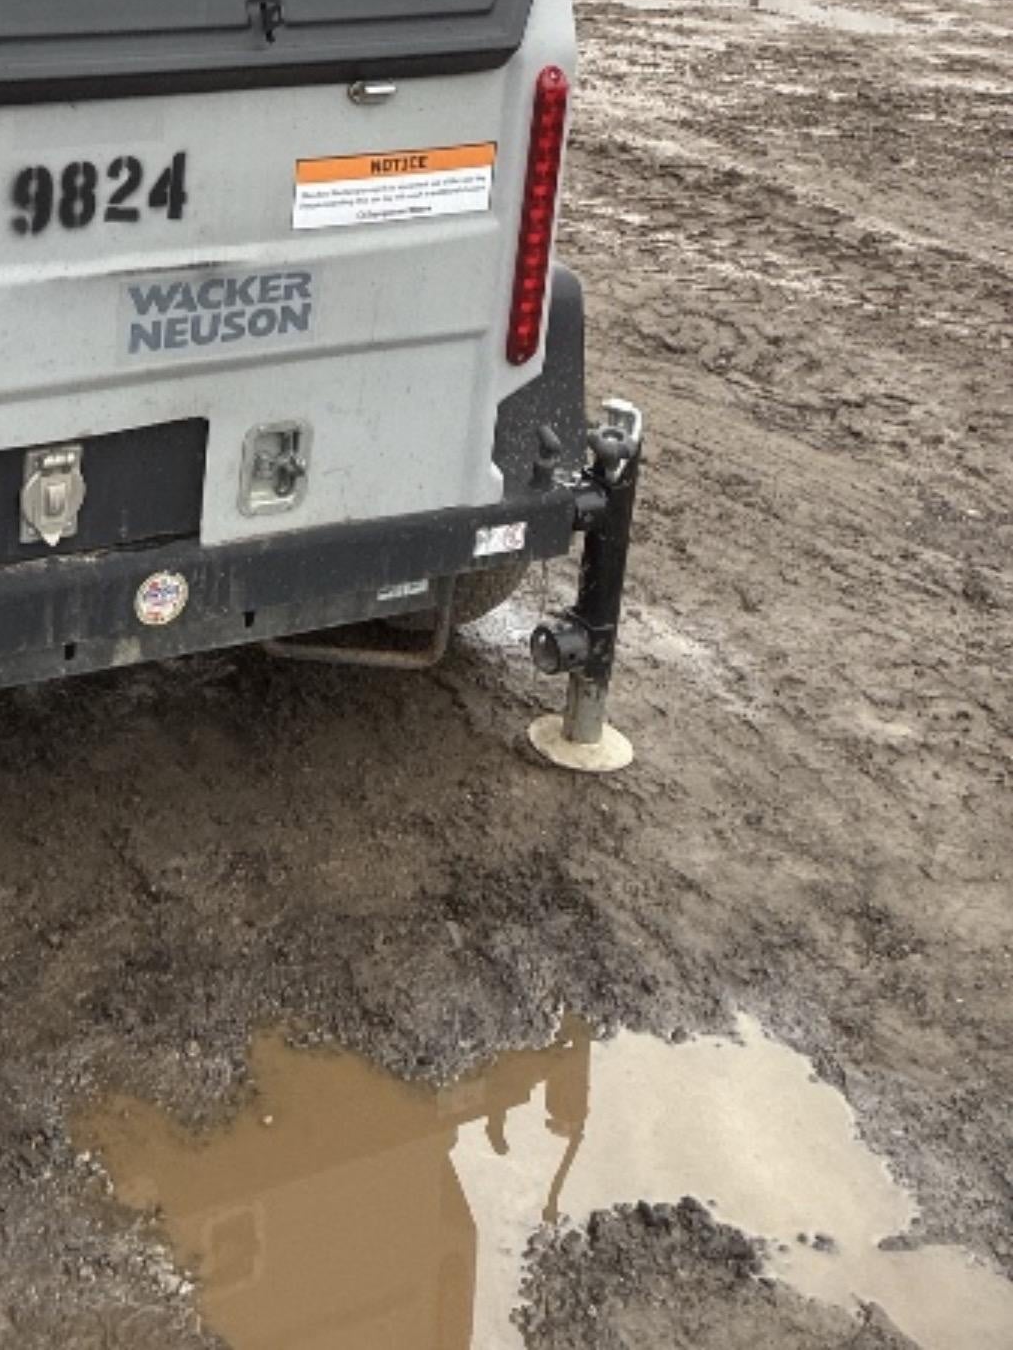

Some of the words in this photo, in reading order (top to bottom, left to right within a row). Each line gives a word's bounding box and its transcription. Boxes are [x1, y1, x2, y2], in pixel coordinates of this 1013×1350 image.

[370, 155, 428, 175] NOTICE
[11, 151, 188, 236] 9824
[128, 272, 312, 315] WACKER
[128, 302, 312, 354] NEUSON
